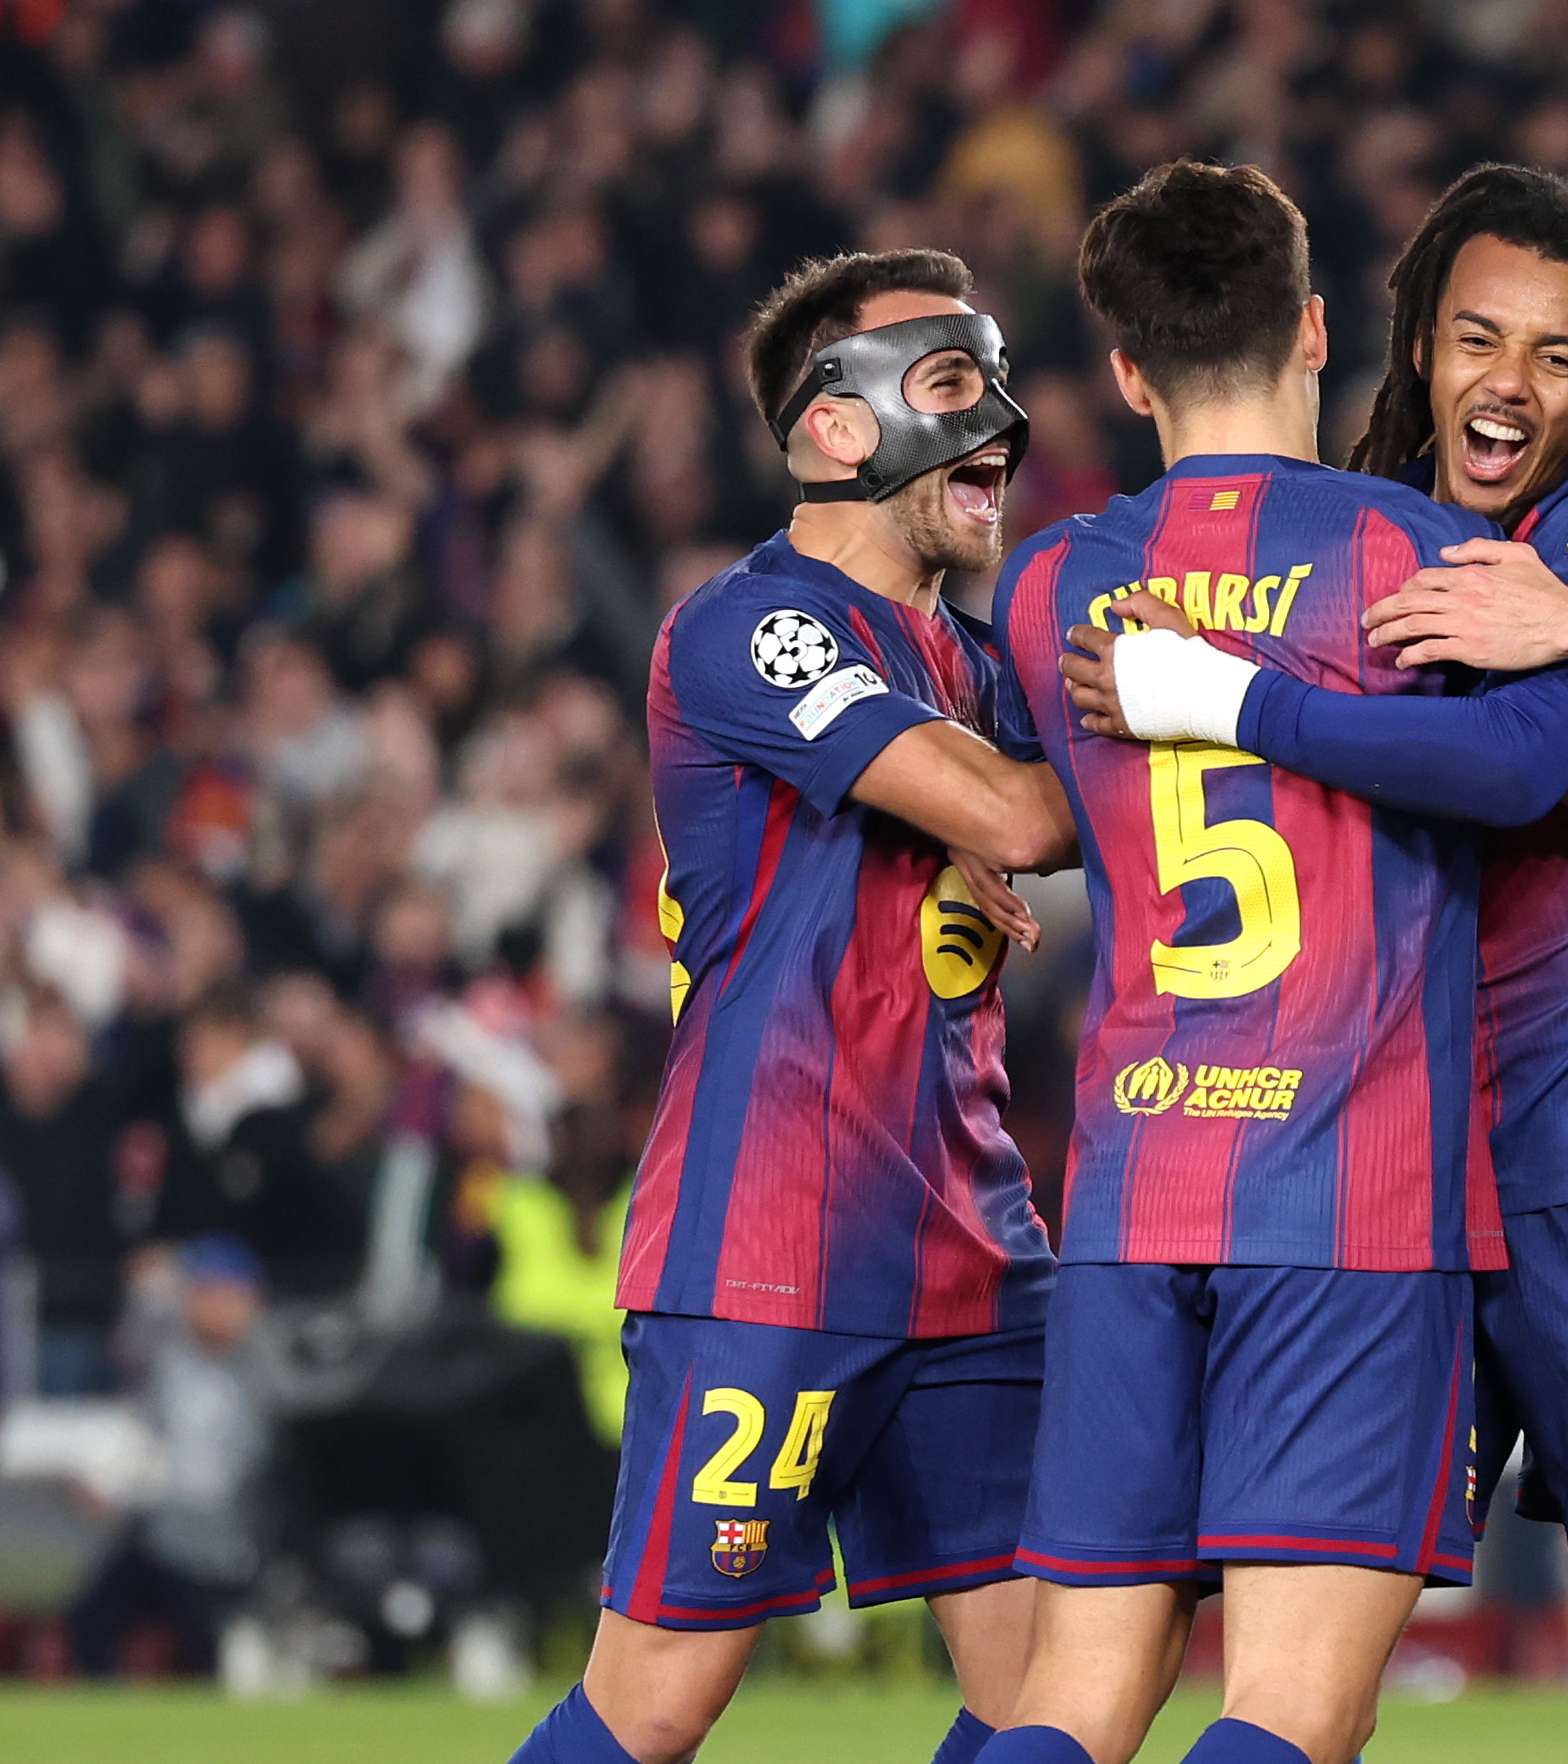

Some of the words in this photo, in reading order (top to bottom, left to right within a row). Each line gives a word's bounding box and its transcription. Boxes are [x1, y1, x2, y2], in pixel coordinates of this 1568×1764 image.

[780, 629, 808, 662] 5
[1149, 739, 1302, 1000] 5
[1194, 1064, 1303, 1090] UNHCR
[1183, 1087, 1295, 1110] ACNUR
[1183, 1106, 1201, 1117] The
[1253, 1110, 1290, 1121] Agency
[691, 1387, 836, 1507] 24
